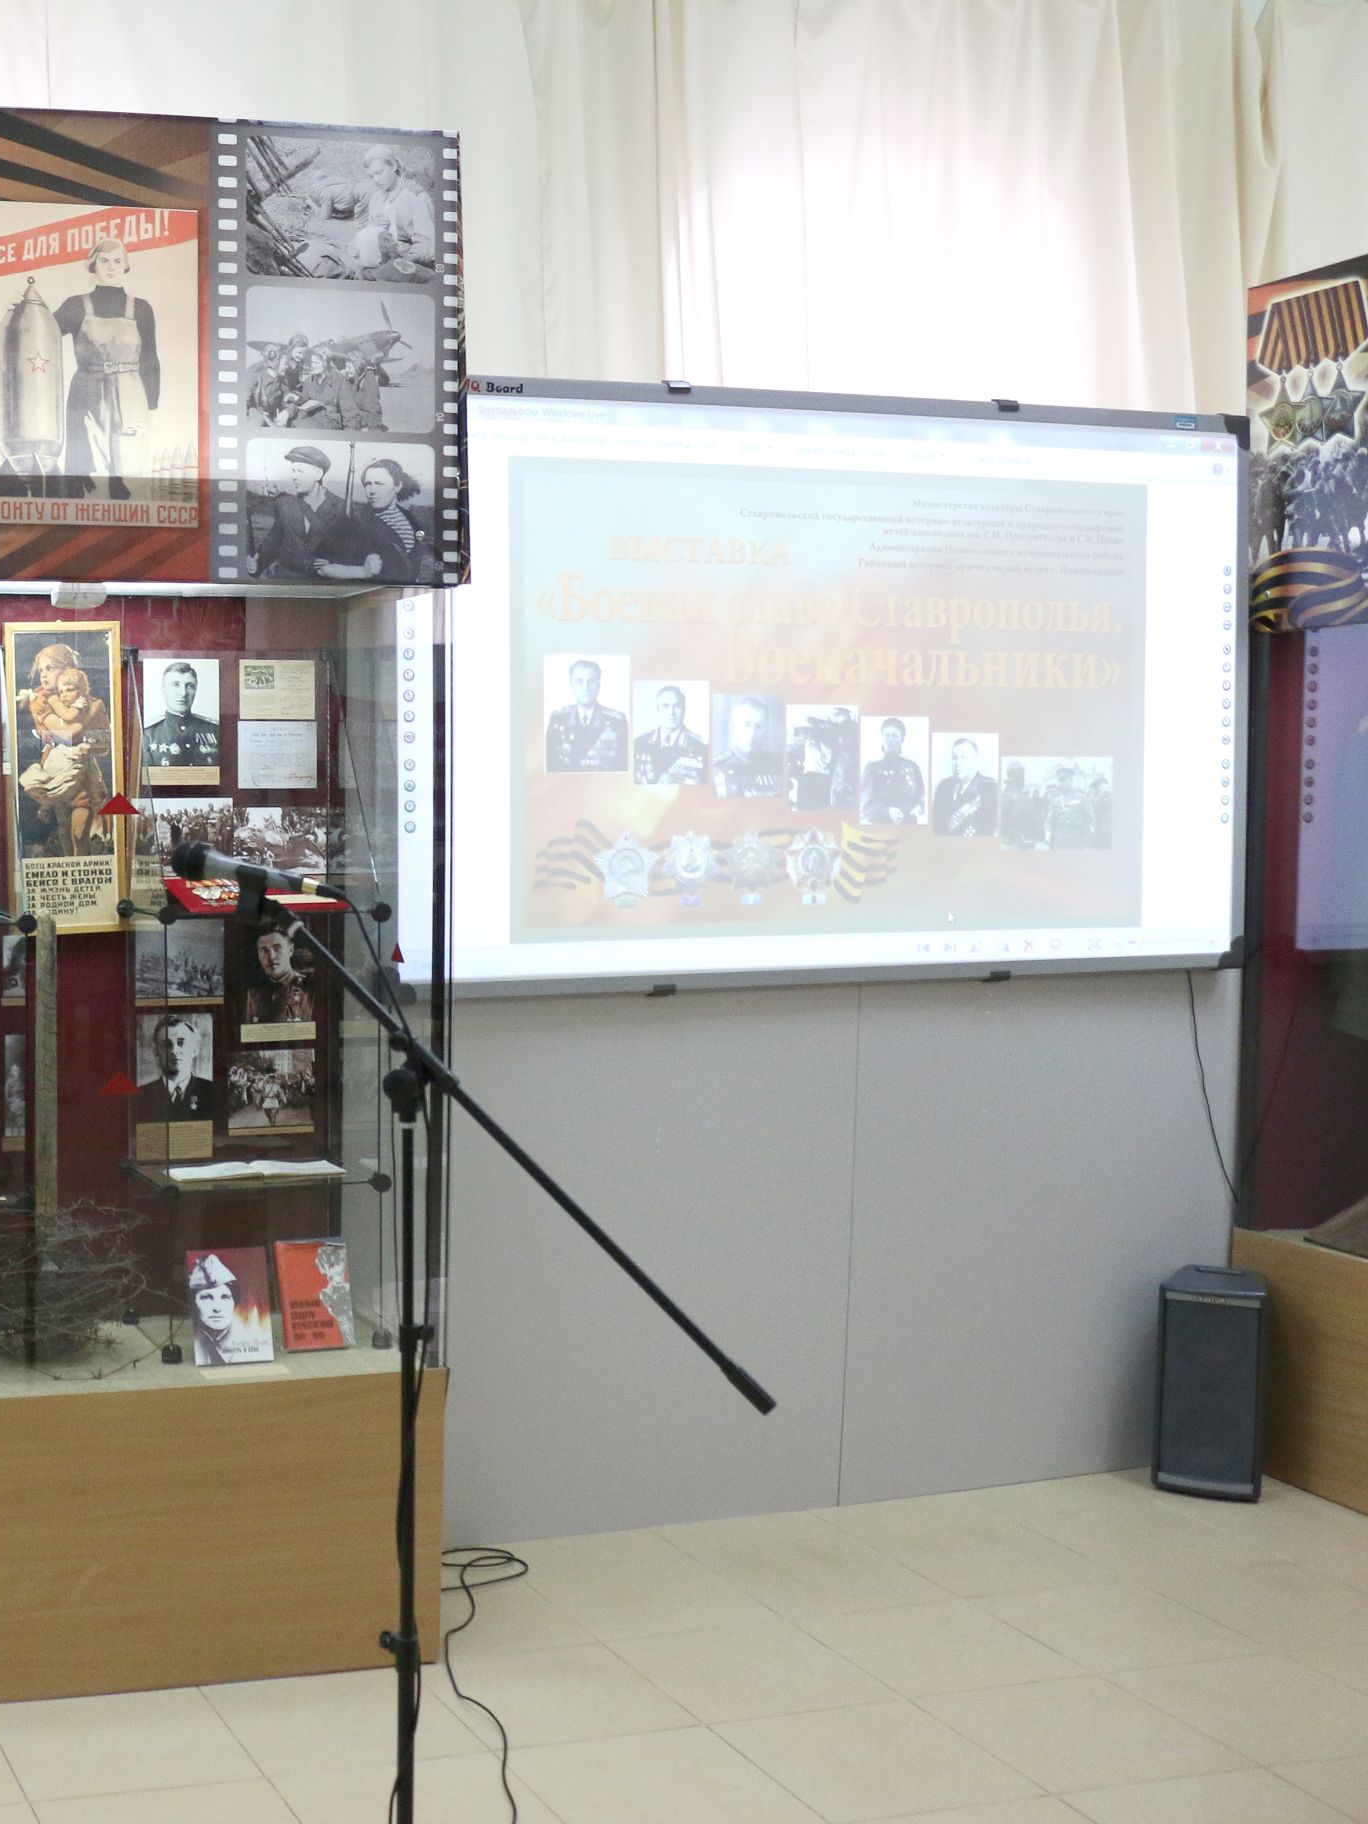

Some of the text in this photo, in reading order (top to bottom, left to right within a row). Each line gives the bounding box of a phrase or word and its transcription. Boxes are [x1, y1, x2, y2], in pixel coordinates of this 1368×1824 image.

[23, 231, 60, 260] ДЛЯ
[66, 209, 169, 255] ПОБЕДЫ!
[486, 382, 523, 394] Board
[540, 407, 584, 418] Windows
[587, 409, 607, 419] Live
[51, 500, 69, 522] ОТ
[74, 501, 151, 525] ЖЕНЩИН
[156, 503, 198, 524] СССР
[739, 506, 821, 520] Ставропольский
[822, 511, 904, 525] государственный
[607, 534, 792, 566] ВЫСТАВКА
[535, 571, 713, 624] «Боевая
[853, 582, 1123, 644] Ставрополья.
[724, 629, 1122, 690] Военачальники»
[47, 861, 81, 869] КРАСНОЙ
[25, 868, 112, 879] СМЕЛО И СТОЙКО
[25, 876, 112, 888] БЕЙСЯ С ВРАГОМ
[40, 894, 67, 902] ЧЕСТЬ
[40, 901, 74, 909] РОДНОЙ
